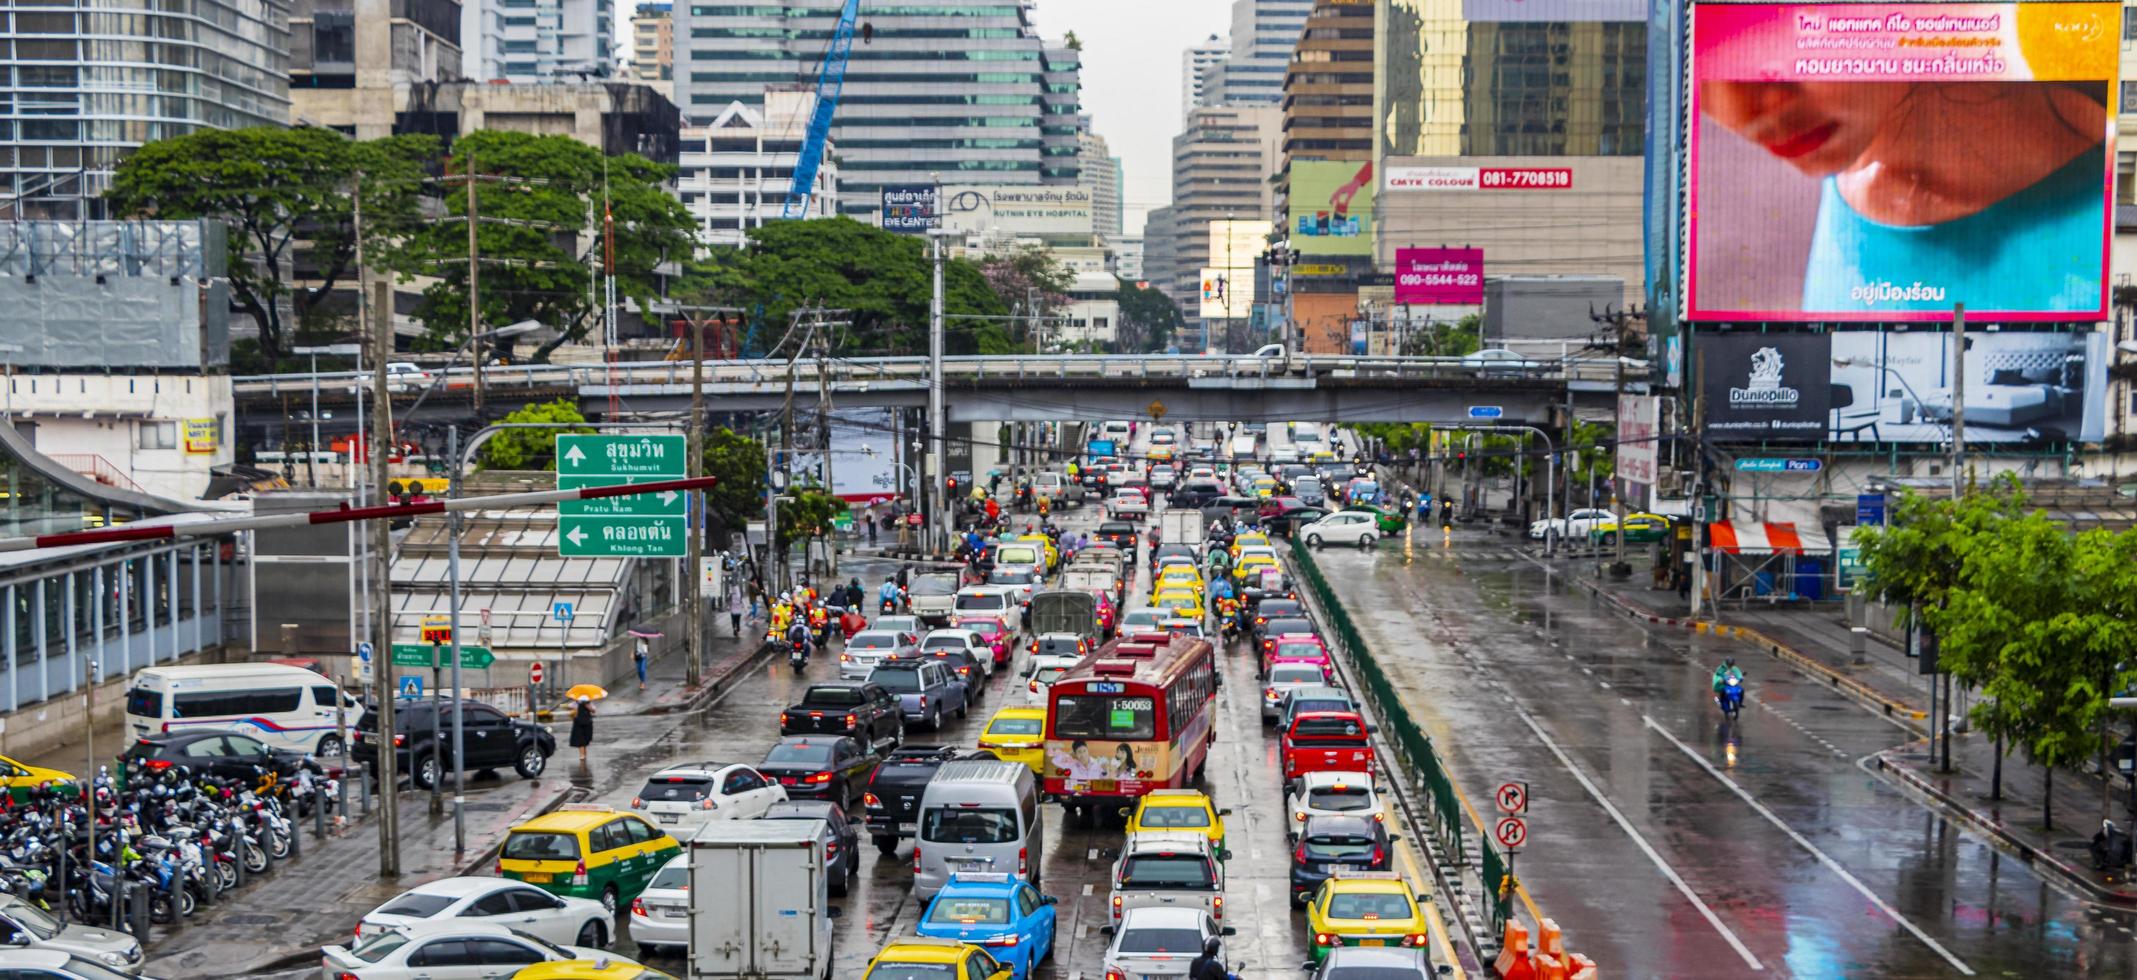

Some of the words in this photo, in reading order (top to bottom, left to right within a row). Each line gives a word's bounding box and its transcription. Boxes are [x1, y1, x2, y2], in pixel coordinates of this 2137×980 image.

[1795, 58, 1898, 75] หอมยาวนาน
[1390, 178, 1423, 186] CMYK
[1428, 178, 1474, 186] COLOUR
[884, 216, 900, 227] EYE
[1850, 281, 1946, 305] อยู่เมืองร้อน
[1731, 389, 1799, 403] Dunlopillo
[606, 437, 665, 464] สุขุมวิท
[611, 463, 660, 472] Sukhumvit
[873, 474, 897, 489] Regu
[583, 504, 609, 513] Pratu
[612, 505, 633, 513] Nam
[602, 519, 672, 541] คลองตัน
[610, 544, 644, 554] Khlong
[647, 544, 664, 552] Tan
